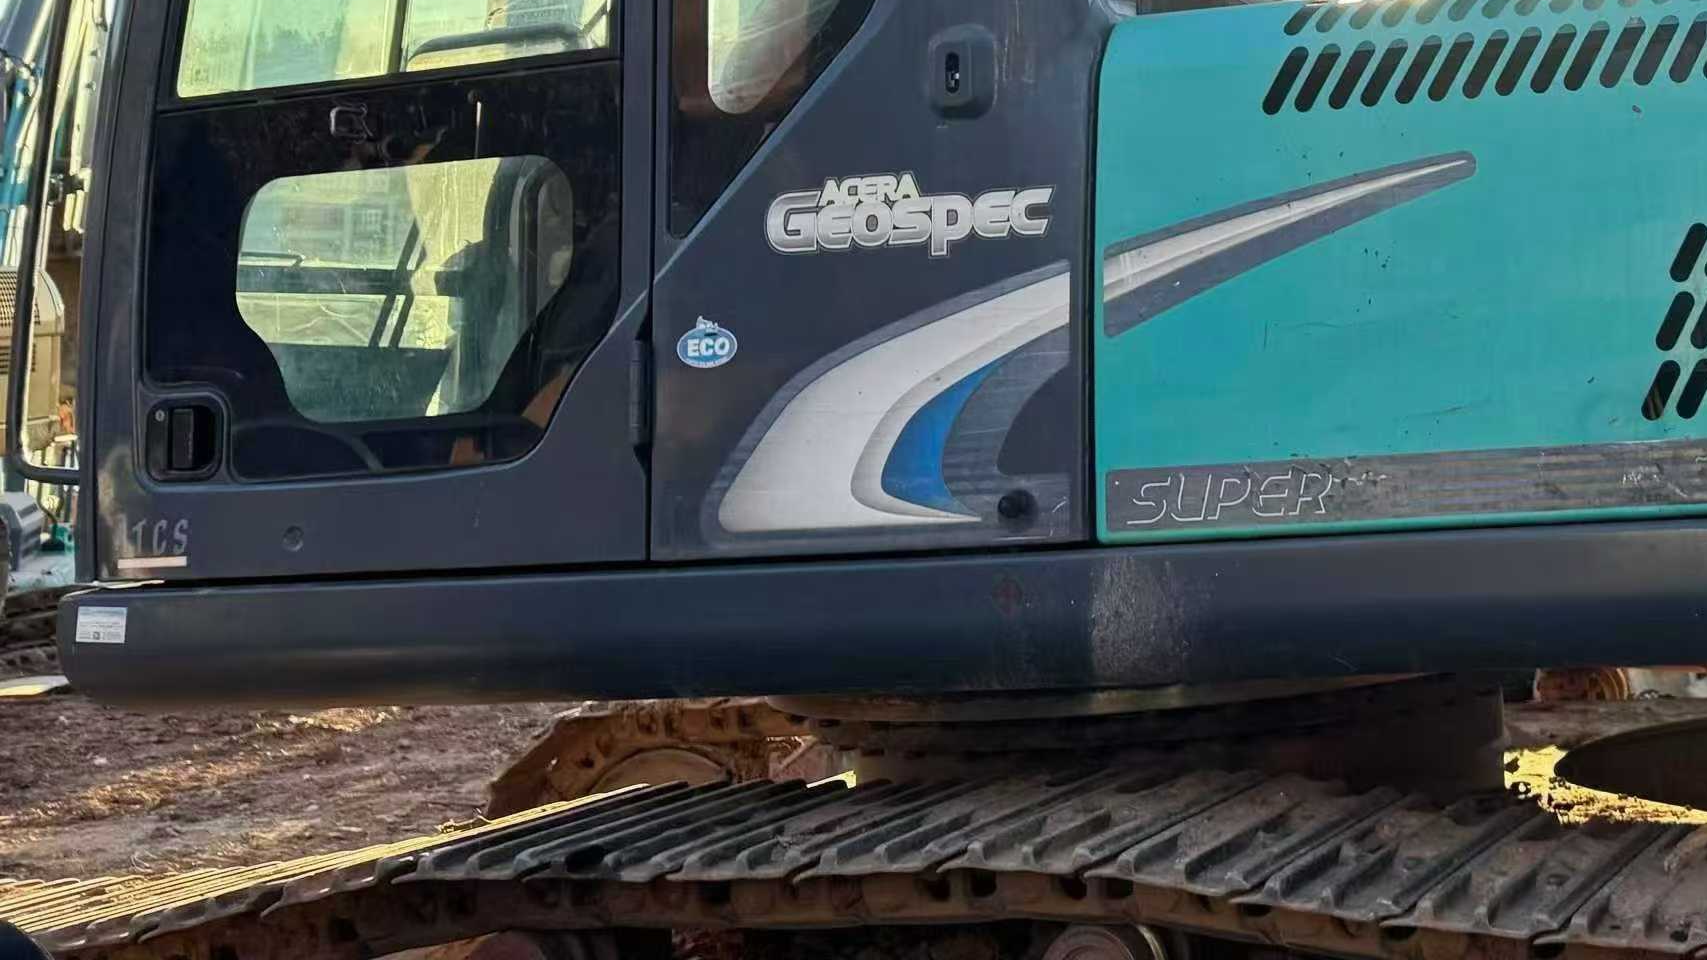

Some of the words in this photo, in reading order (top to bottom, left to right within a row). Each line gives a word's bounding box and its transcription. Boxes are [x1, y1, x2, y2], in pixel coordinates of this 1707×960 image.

[817, 171, 922, 208] ACERA
[687, 337, 731, 357] ECO
[1126, 470, 1334, 525] SUPER
